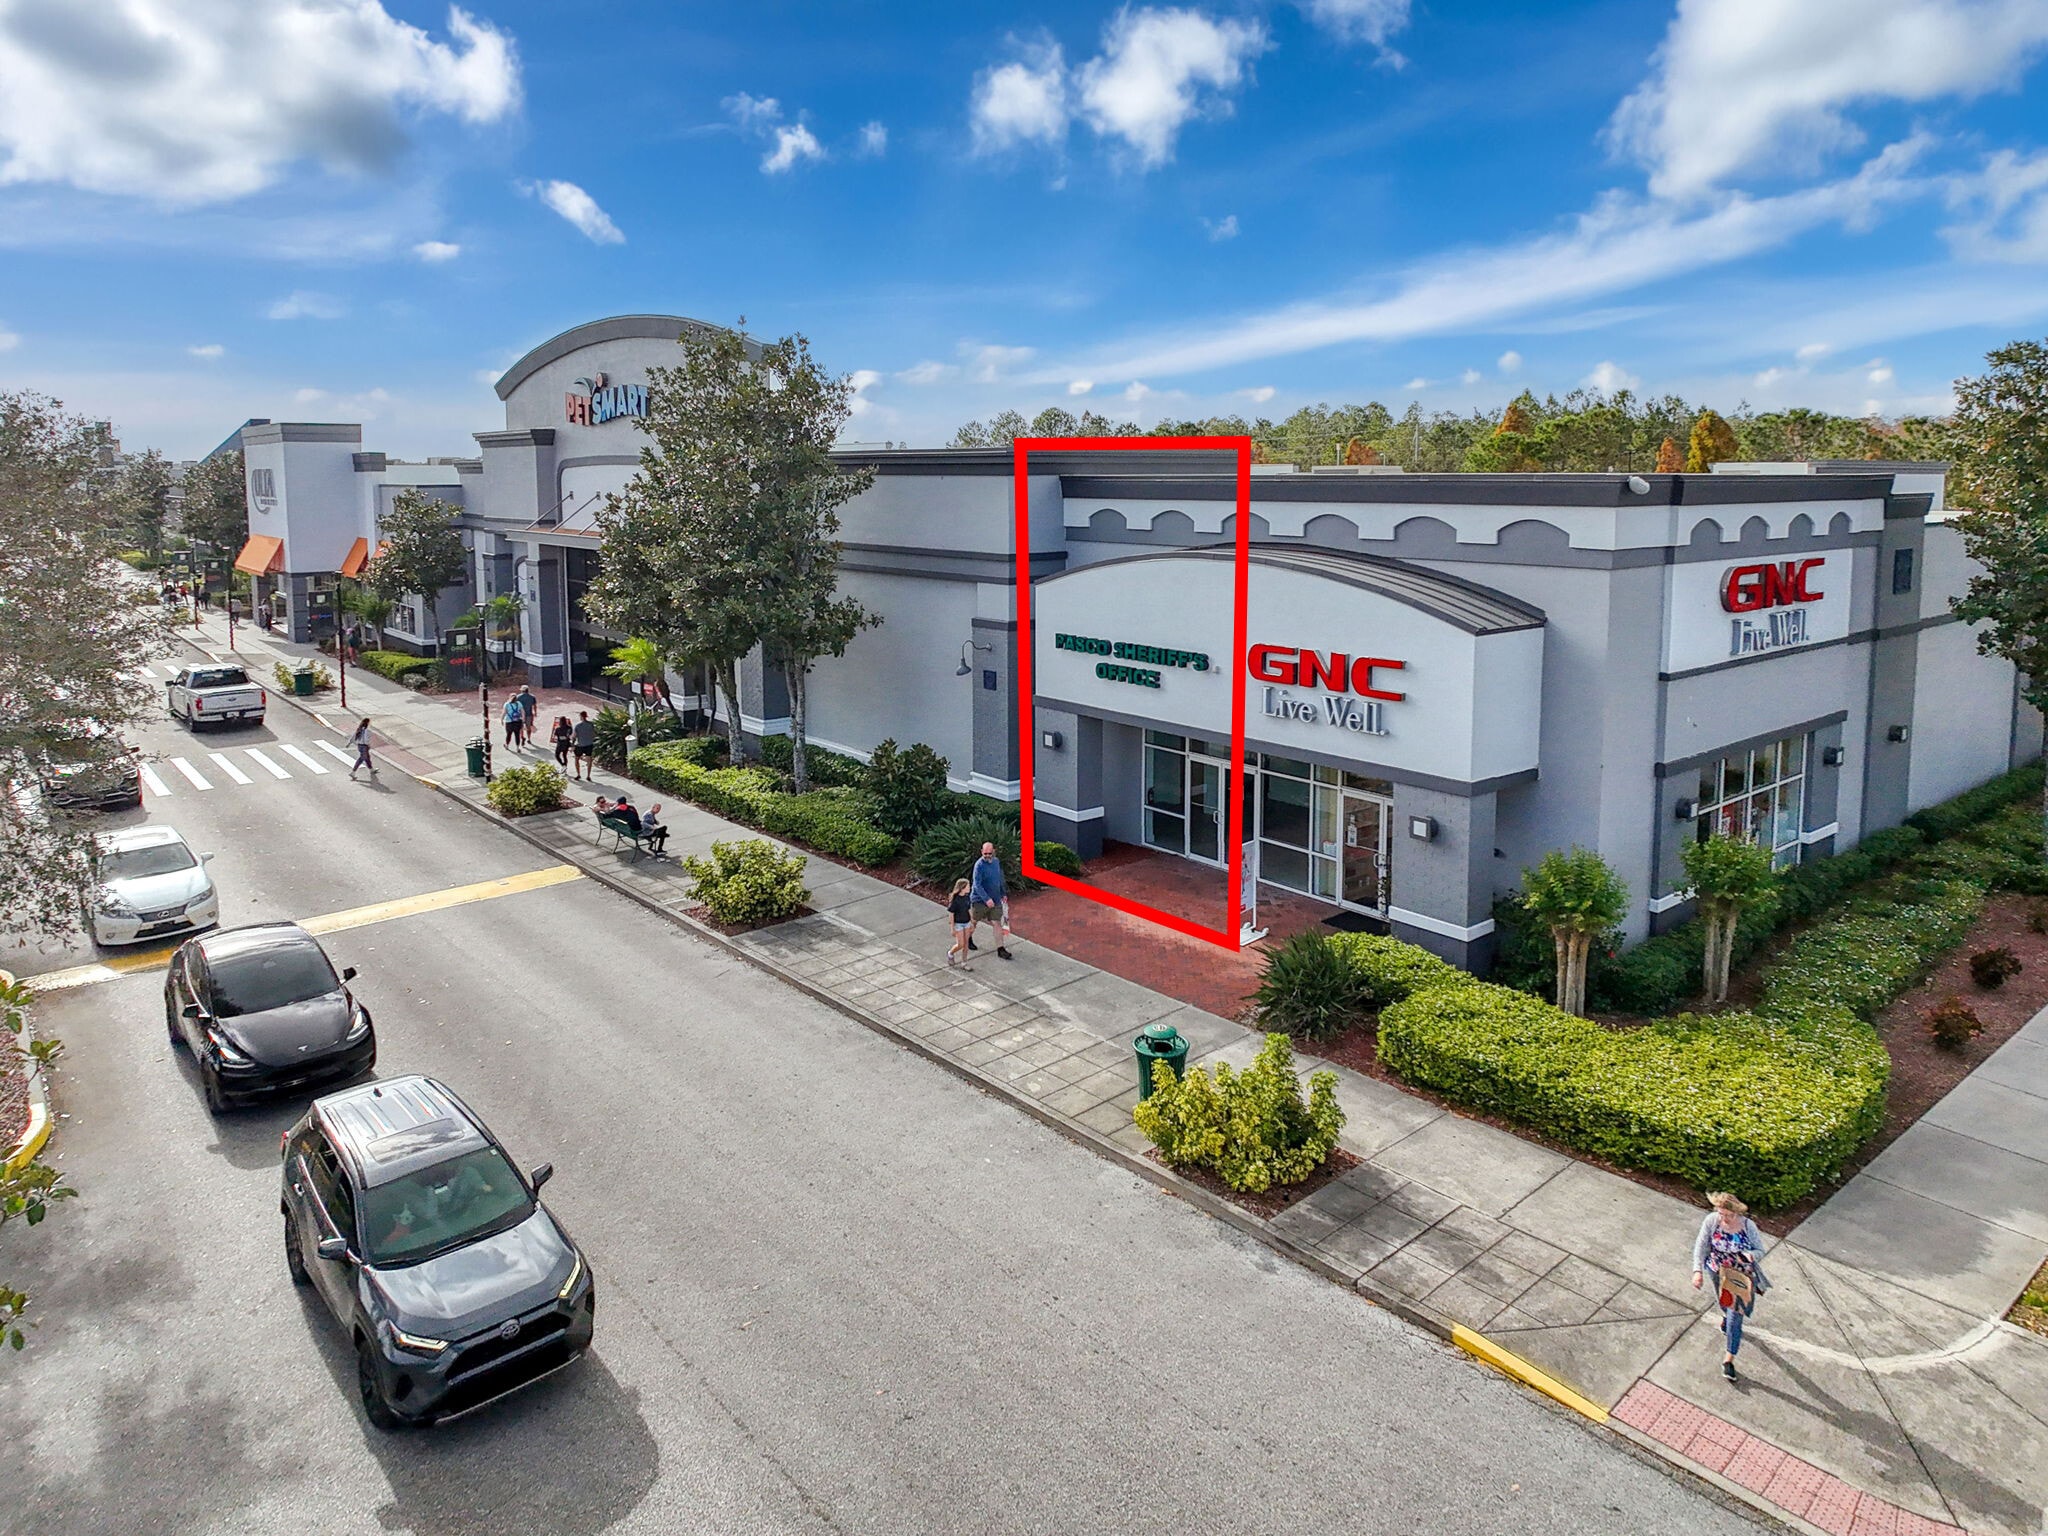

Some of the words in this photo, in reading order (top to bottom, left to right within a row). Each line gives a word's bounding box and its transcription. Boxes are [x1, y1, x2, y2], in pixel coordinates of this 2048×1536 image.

[1720, 557, 1825, 613] GNC
[1055, 633, 1113, 656] PASCO
[1113, 641, 1210, 672] SHERIFF'S
[1731, 618, 1772, 656] Live
[1095, 662, 1162, 689] OFFICE
[1248, 643, 1408, 702] GNC
[1261, 686, 1318, 724] Live
[1321, 695, 1391, 737] Well.
